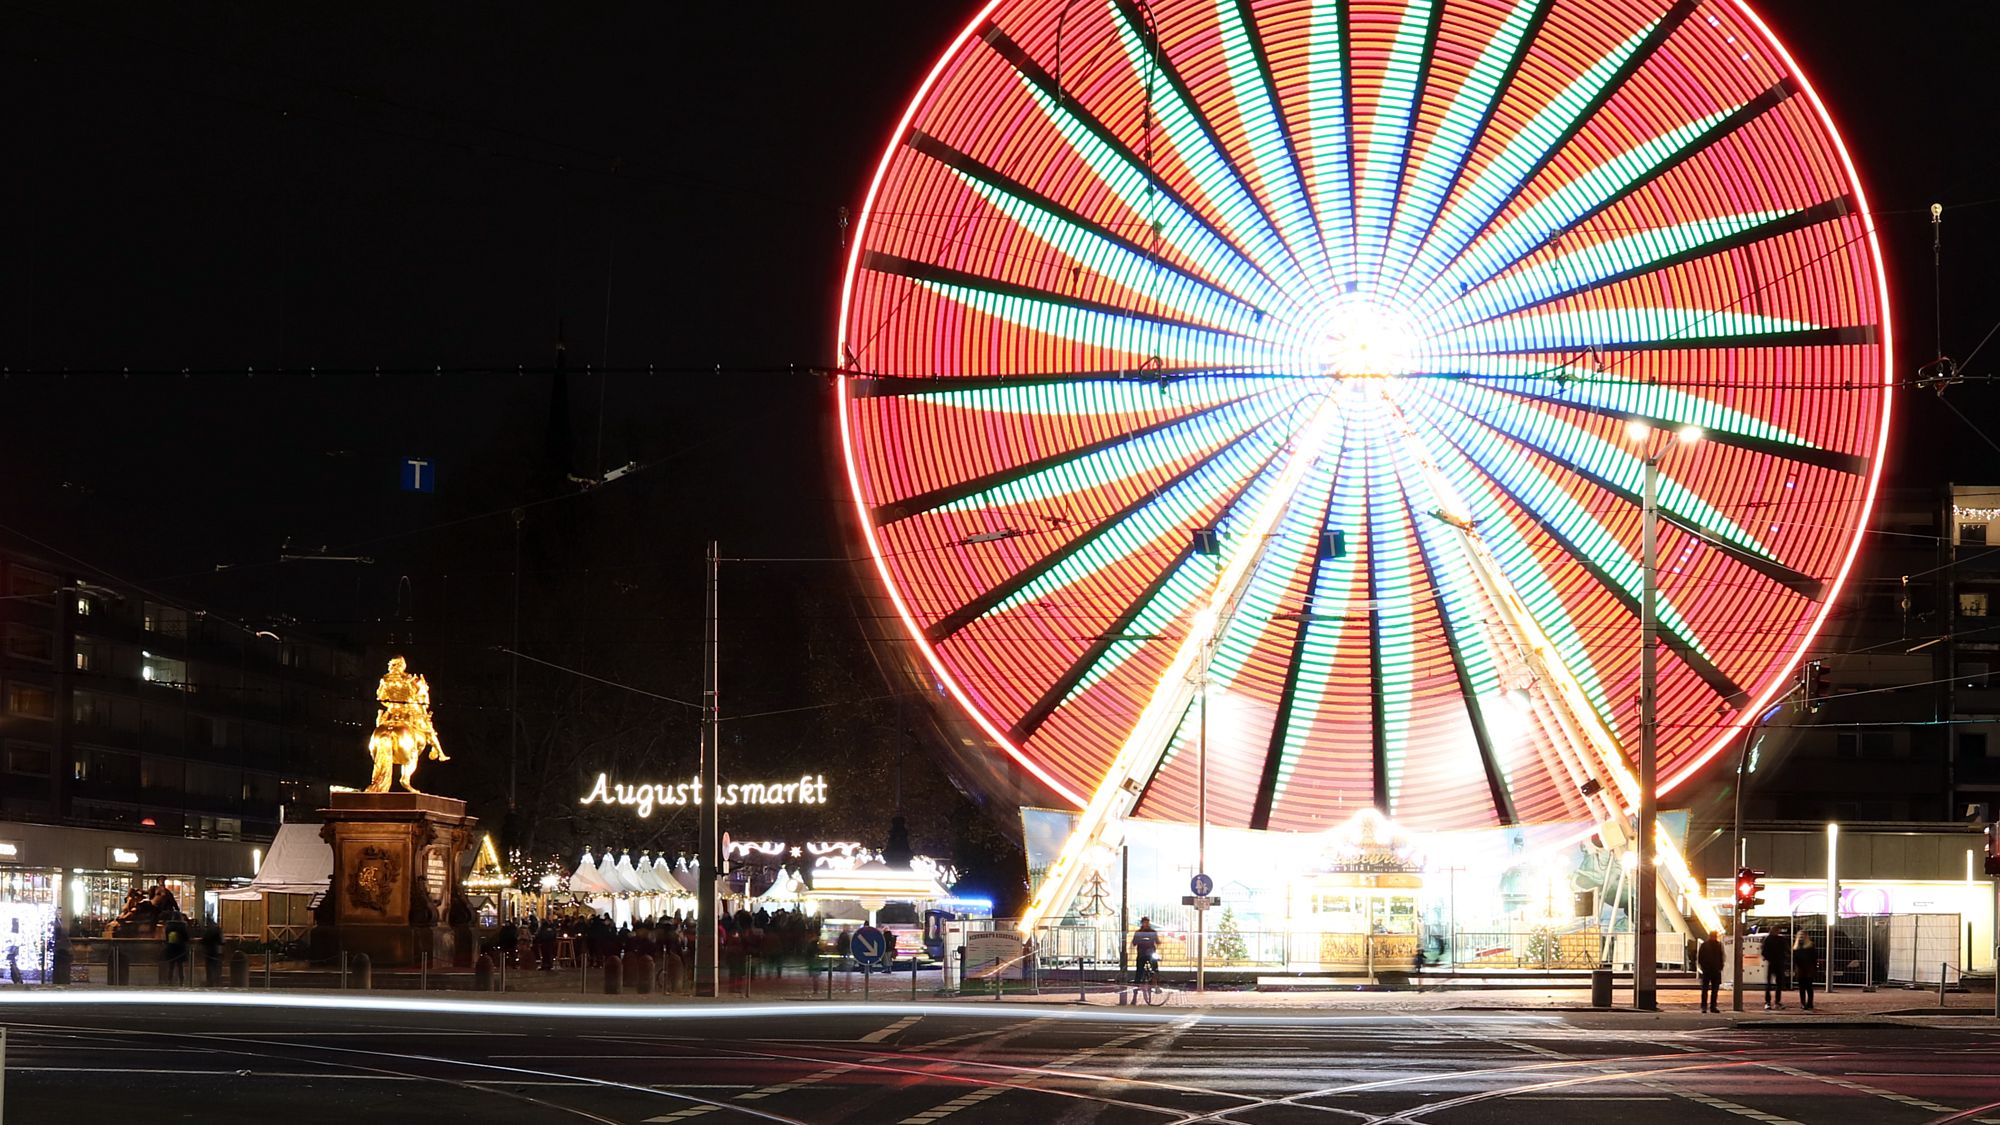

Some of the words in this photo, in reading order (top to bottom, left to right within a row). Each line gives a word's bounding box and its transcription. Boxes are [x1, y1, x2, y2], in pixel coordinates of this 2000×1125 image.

[408, 460, 428, 489] T
[1196, 530, 1212, 553] T
[1323, 531, 1340, 557] T
